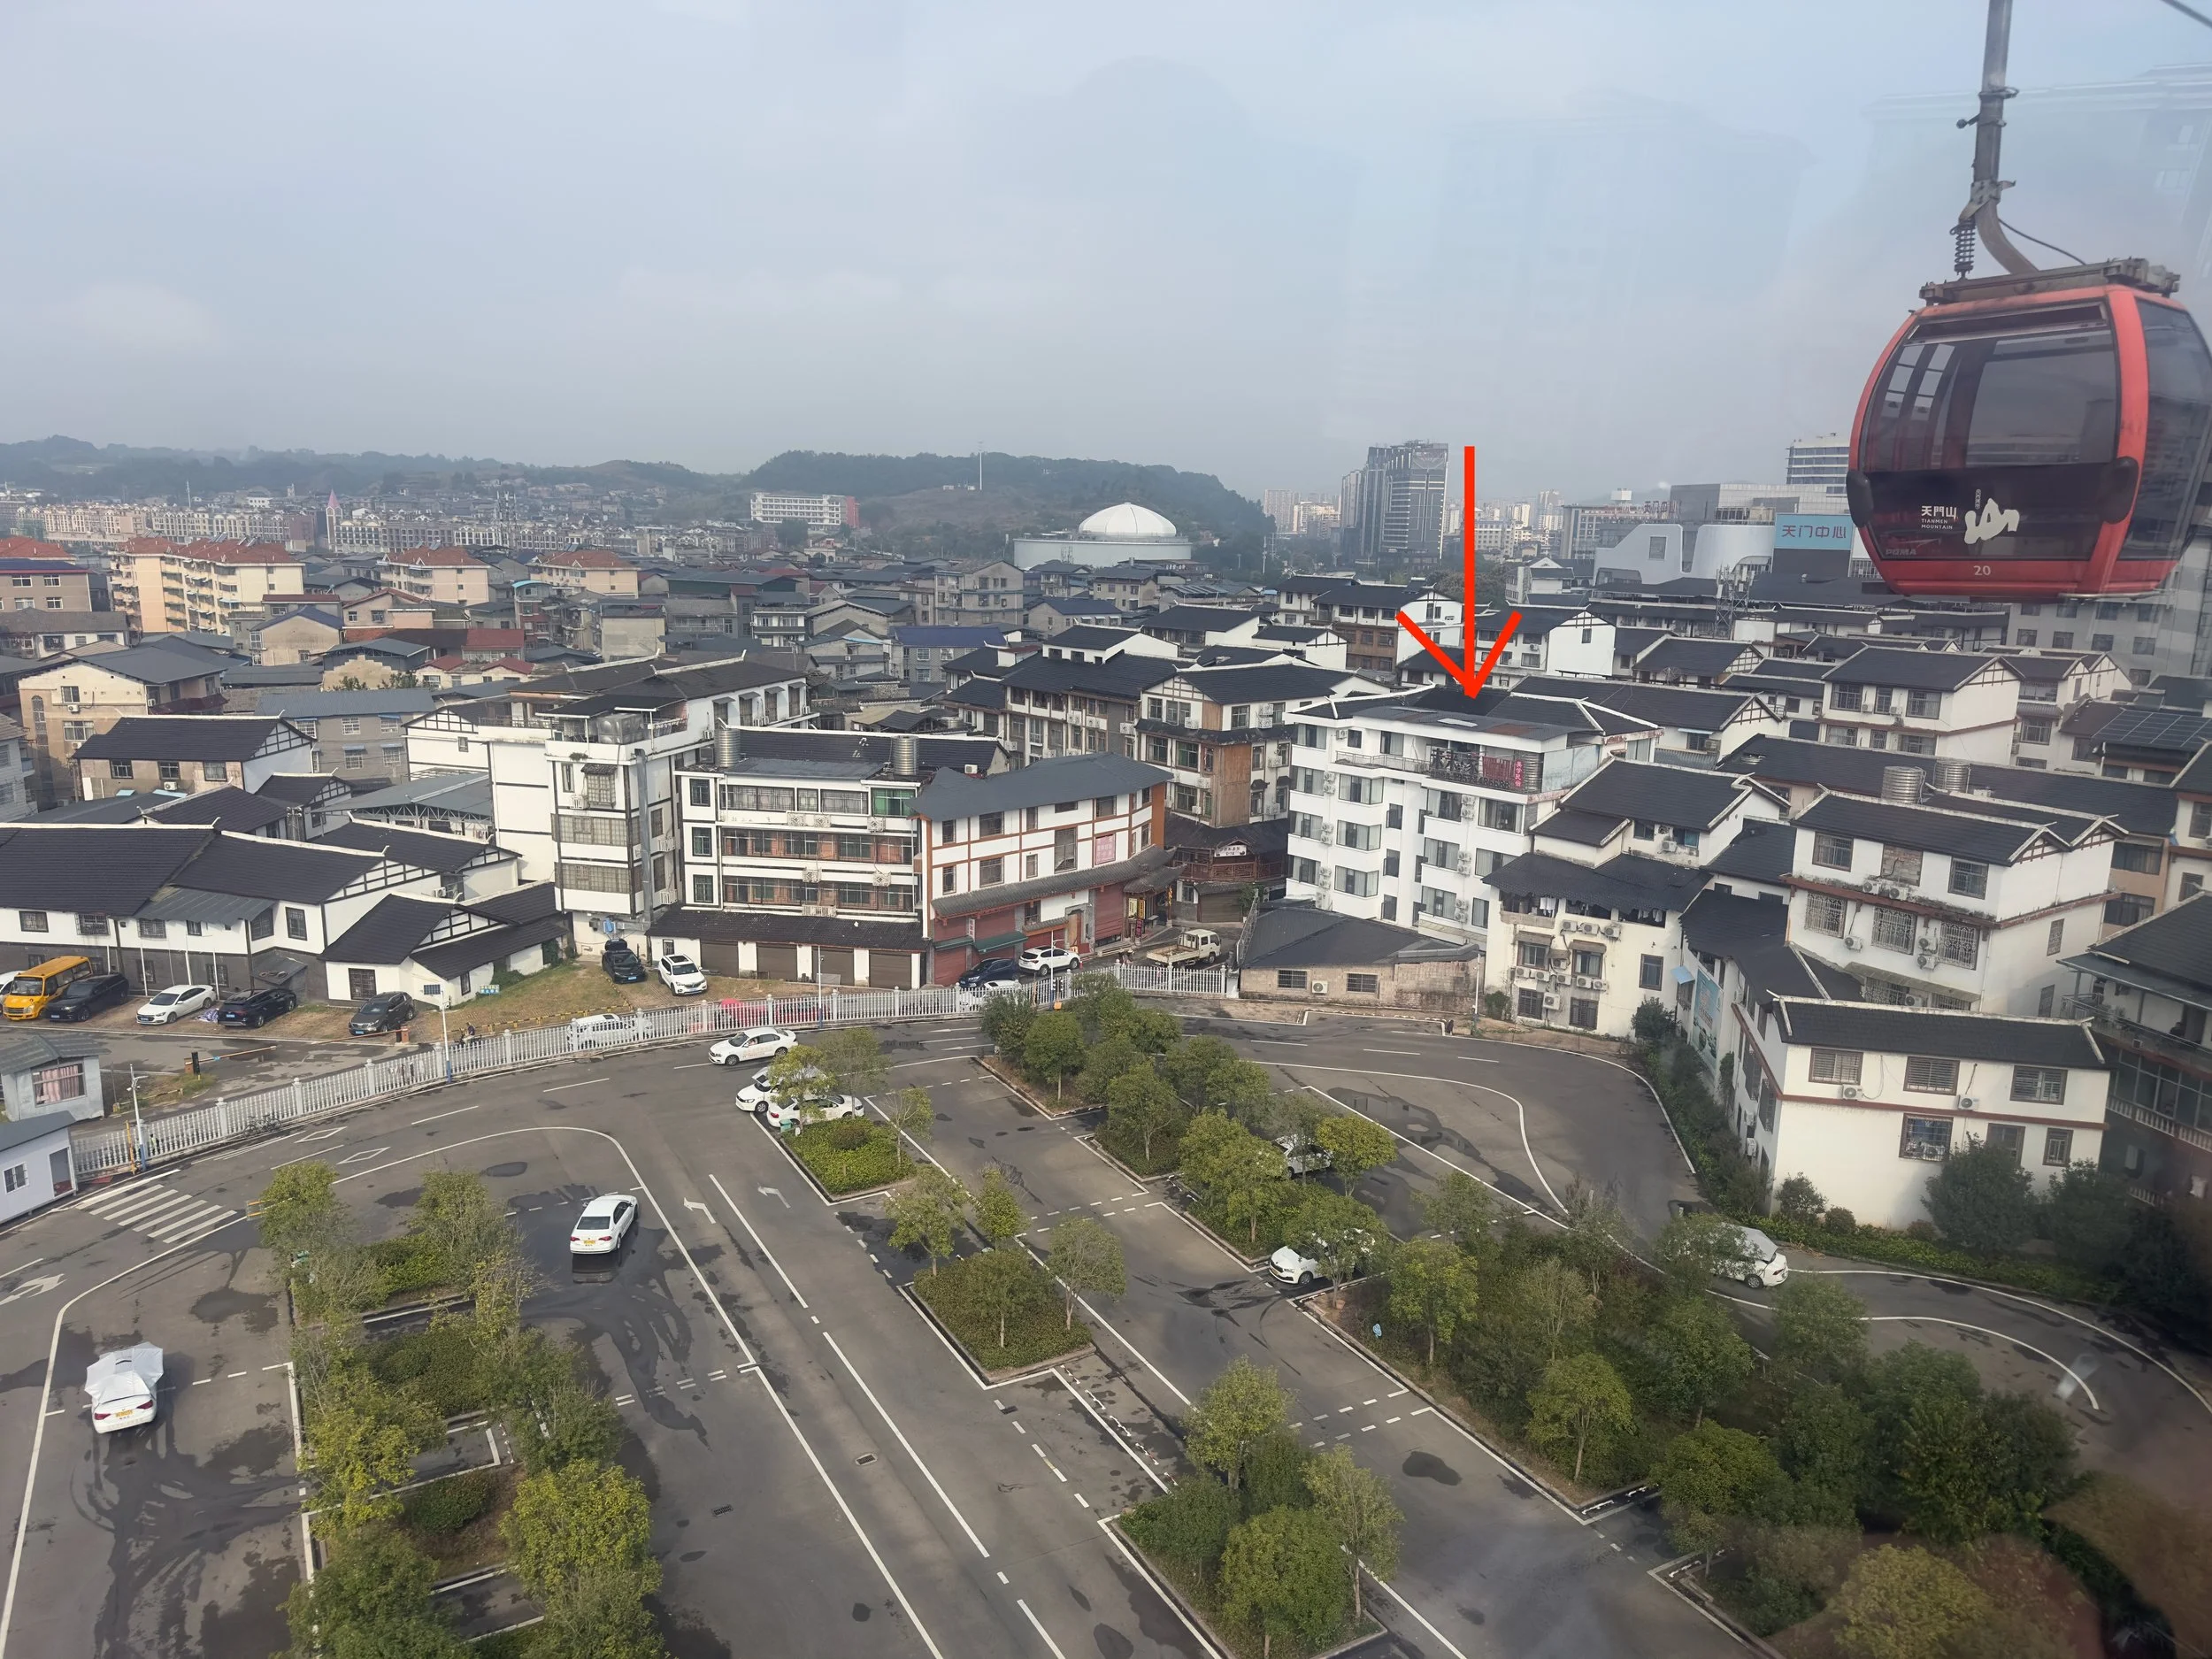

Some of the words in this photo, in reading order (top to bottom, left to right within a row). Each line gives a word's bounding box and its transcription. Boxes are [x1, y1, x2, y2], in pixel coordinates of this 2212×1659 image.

[1921, 505, 1957, 519] 天門山
[1781, 525, 1847, 539] 天门中心
[1973, 565, 1991, 576] 20
